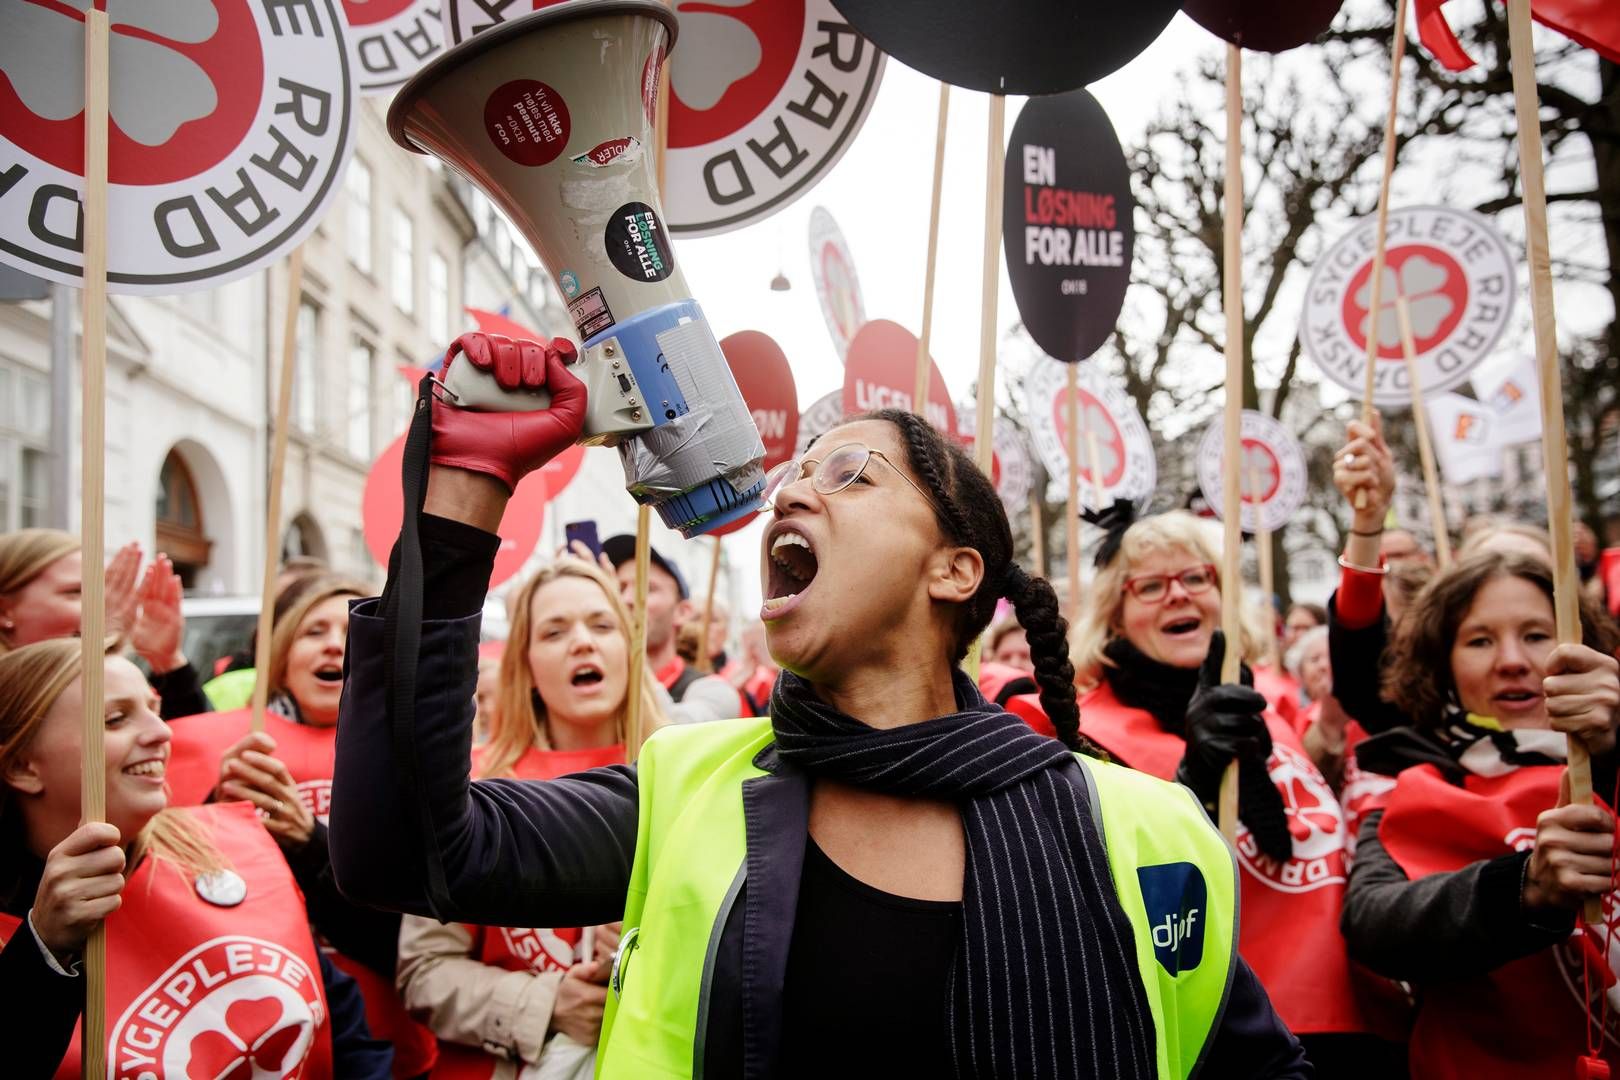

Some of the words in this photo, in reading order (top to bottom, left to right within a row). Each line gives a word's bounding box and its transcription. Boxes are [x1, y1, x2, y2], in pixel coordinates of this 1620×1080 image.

[535, 88, 547, 101] Vi
[541, 100, 553, 113] vil
[513, 102, 542, 143] peanuts
[523, 92, 542, 120] nøjes
[537, 120, 556, 143] med
[546, 112, 563, 136] ikke
[1023, 144, 1056, 186] EN
[645, 212, 657, 230] EN
[1024, 186, 1117, 229] LØSNING
[624, 215, 642, 243] FOR
[635, 245, 657, 278] ALLE
[635, 213, 663, 270] LØSNING
[1025, 225, 1072, 266] FOR
[1072, 229, 1124, 267] ALLE
